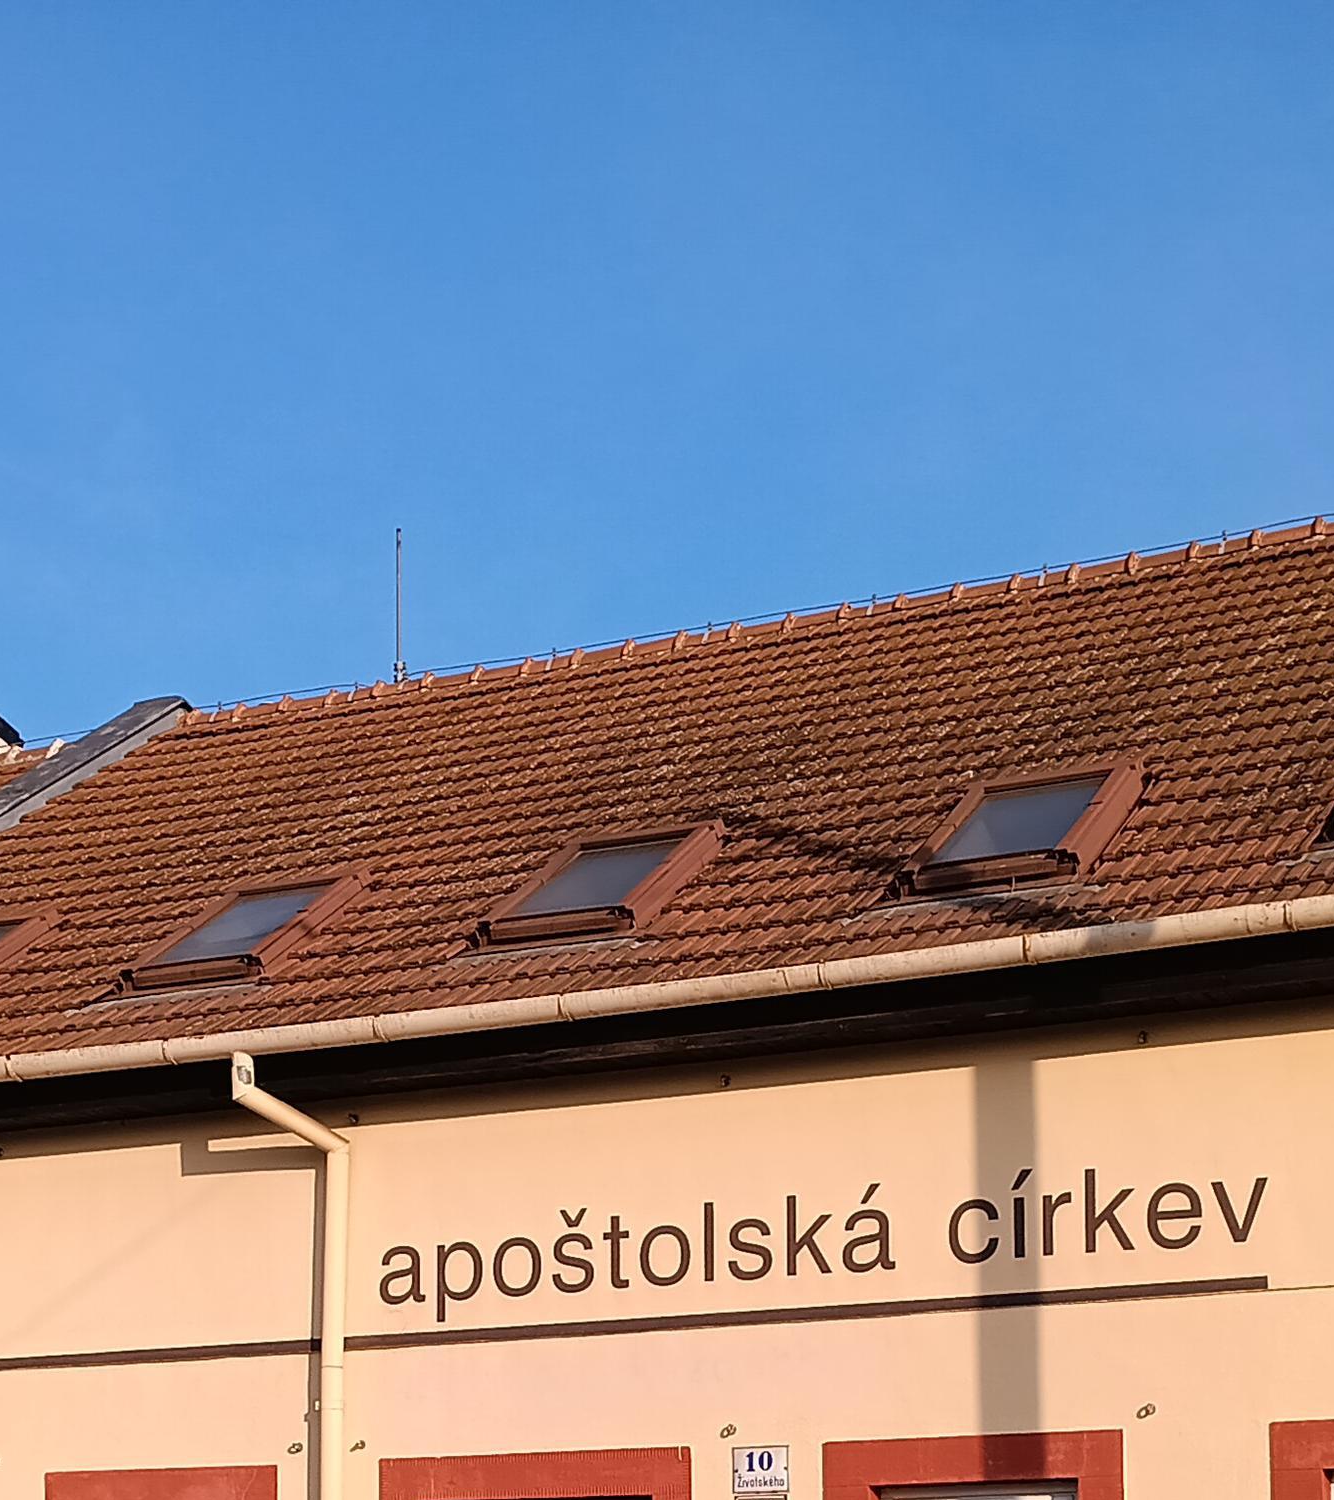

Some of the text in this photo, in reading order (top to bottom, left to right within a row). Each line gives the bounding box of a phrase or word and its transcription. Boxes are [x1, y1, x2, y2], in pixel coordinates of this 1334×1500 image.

[378, 1168, 1268, 1322] apoštolská církev
[745, 1451, 773, 1472] 10
